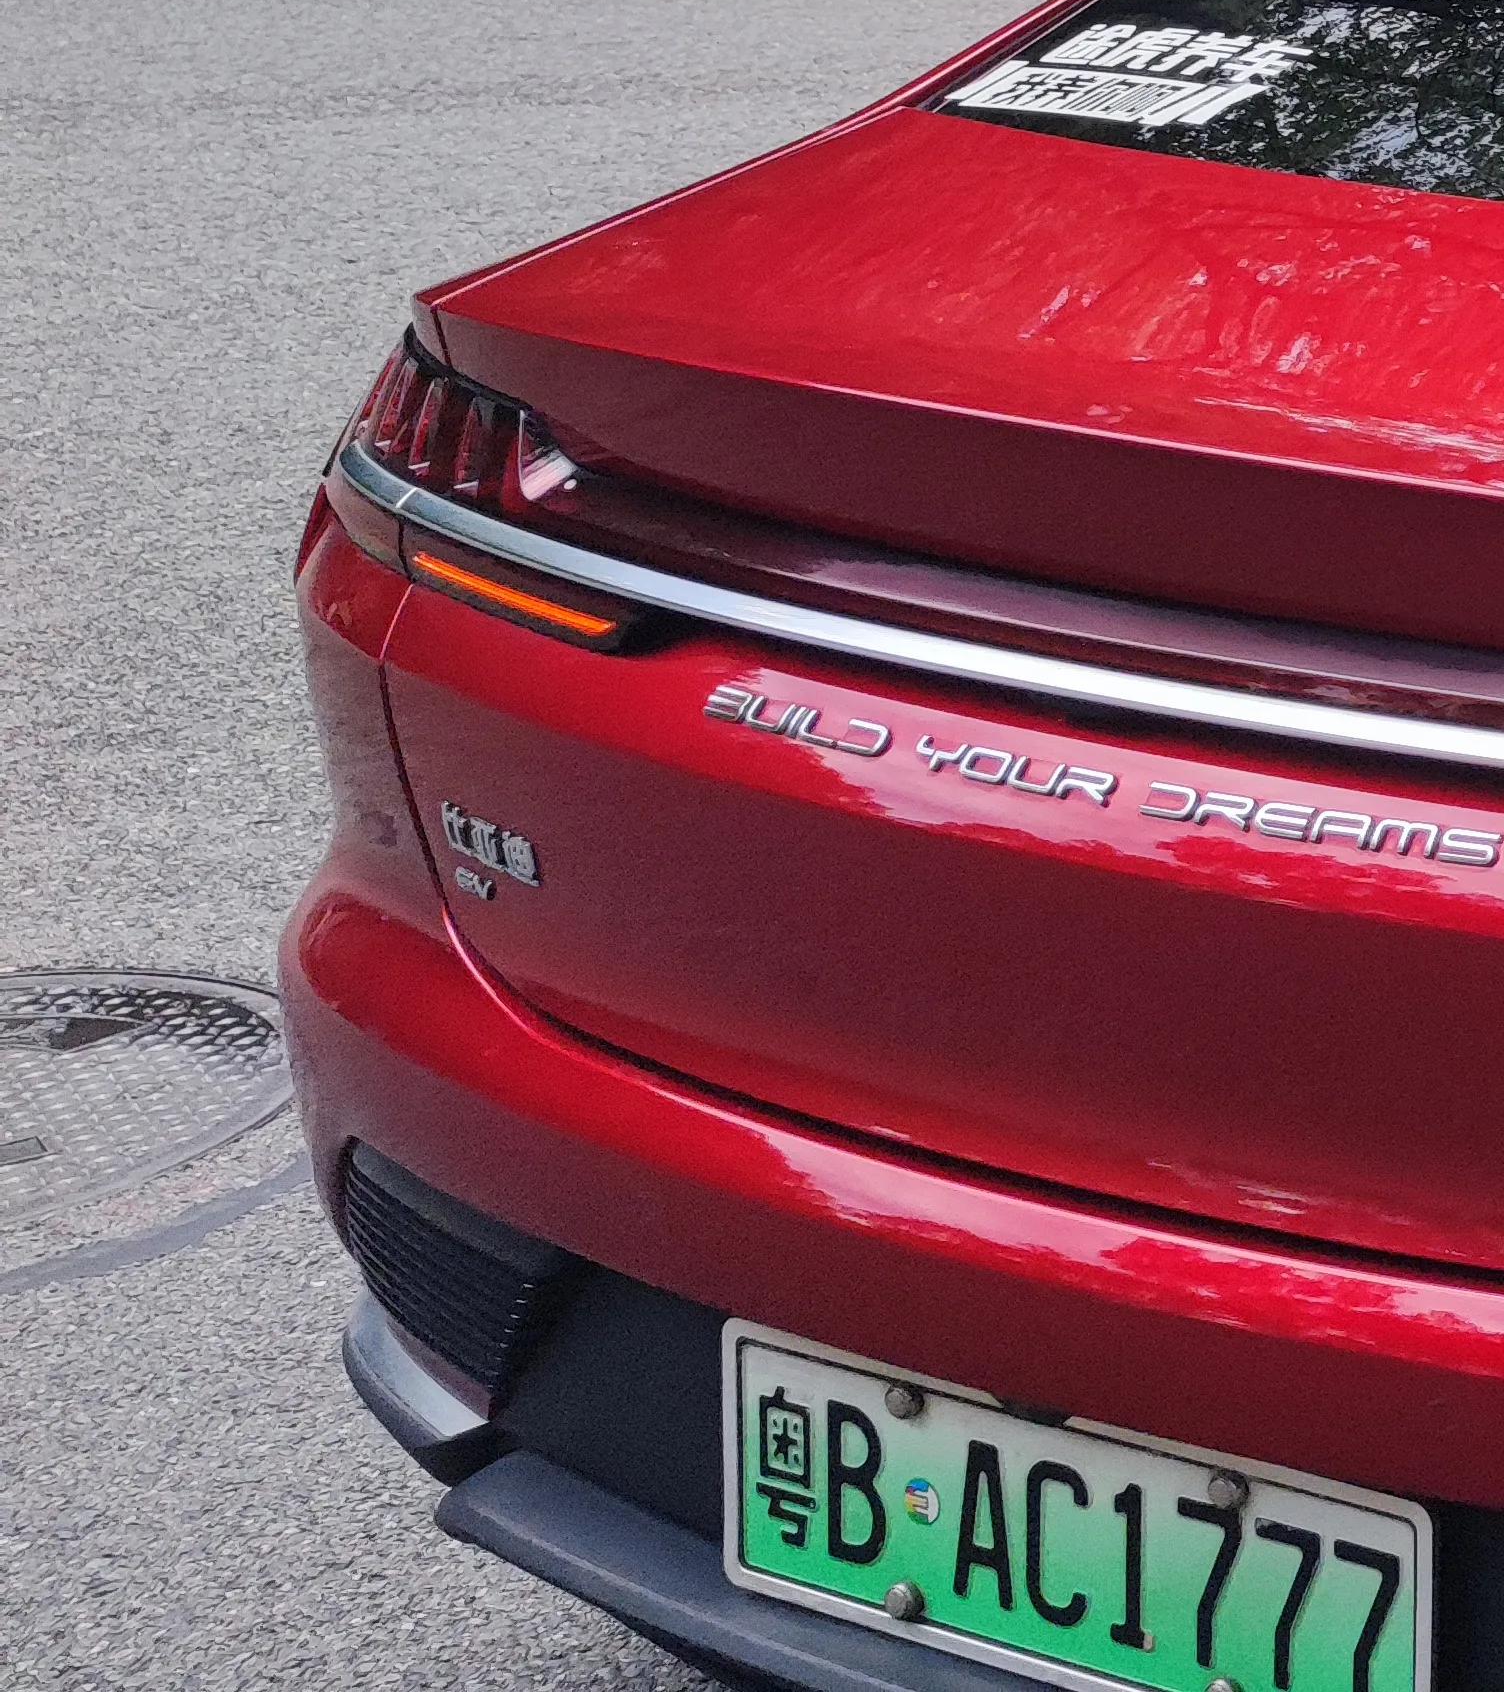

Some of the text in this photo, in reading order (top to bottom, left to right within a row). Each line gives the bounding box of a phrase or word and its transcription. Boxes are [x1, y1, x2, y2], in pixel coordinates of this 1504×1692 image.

[1039, 23, 1313, 82] 途虎养车
[703, 684, 893, 758] BUILD
[916, 733, 1118, 807] YOUR
